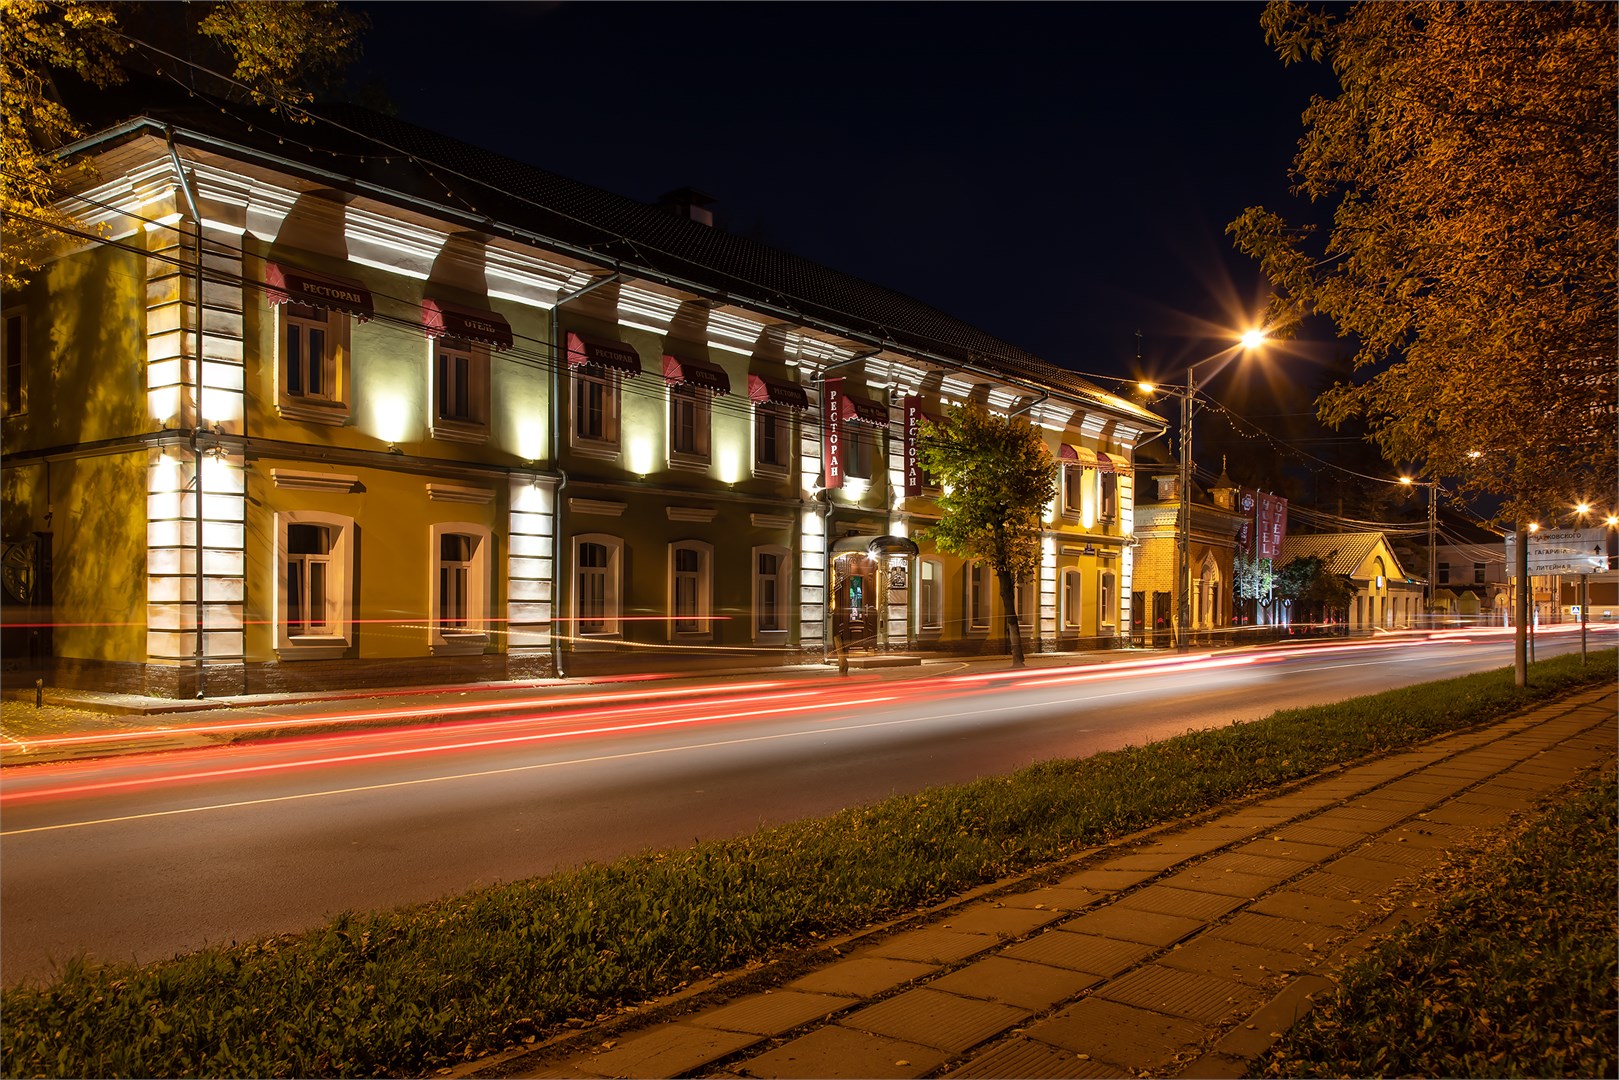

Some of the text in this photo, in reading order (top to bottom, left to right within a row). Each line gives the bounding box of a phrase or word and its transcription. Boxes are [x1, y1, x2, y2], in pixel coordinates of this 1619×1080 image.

[302, 281, 361, 304] РЕСТОРАН
[594, 348, 633, 363] РЕСТОРАН
[830, 390, 838, 477] РЕСТОРАН
[909, 407, 917, 486] РЕСТОРАН
[1272, 501, 1283, 556] ОТЕЛЬ
